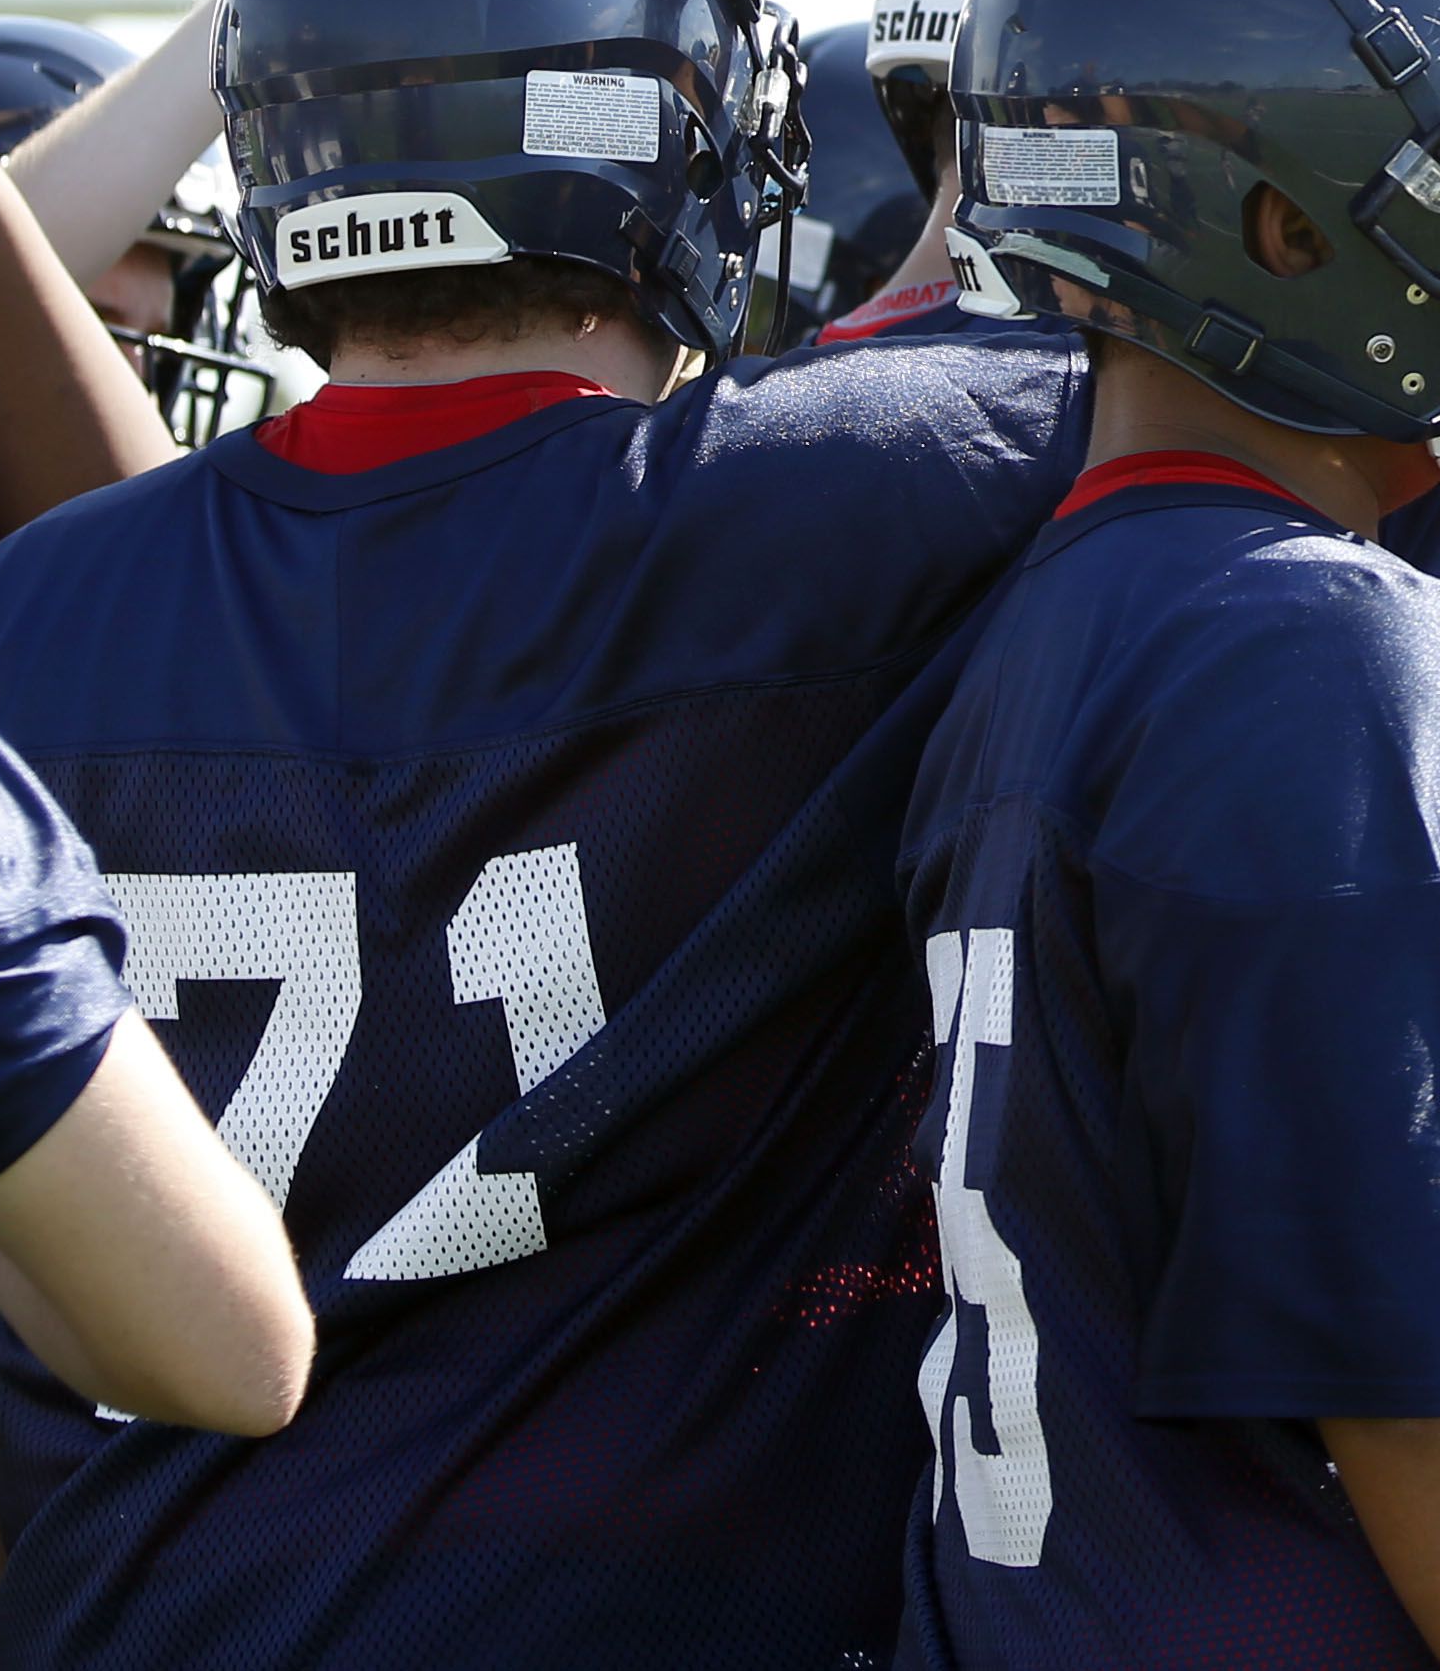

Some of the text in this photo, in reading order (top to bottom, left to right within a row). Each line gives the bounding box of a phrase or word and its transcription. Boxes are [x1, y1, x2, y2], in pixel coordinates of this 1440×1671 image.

[573, 75, 626, 89] WARNING
[290, 207, 455, 263] schutt
[100, 842, 606, 1424] 71
